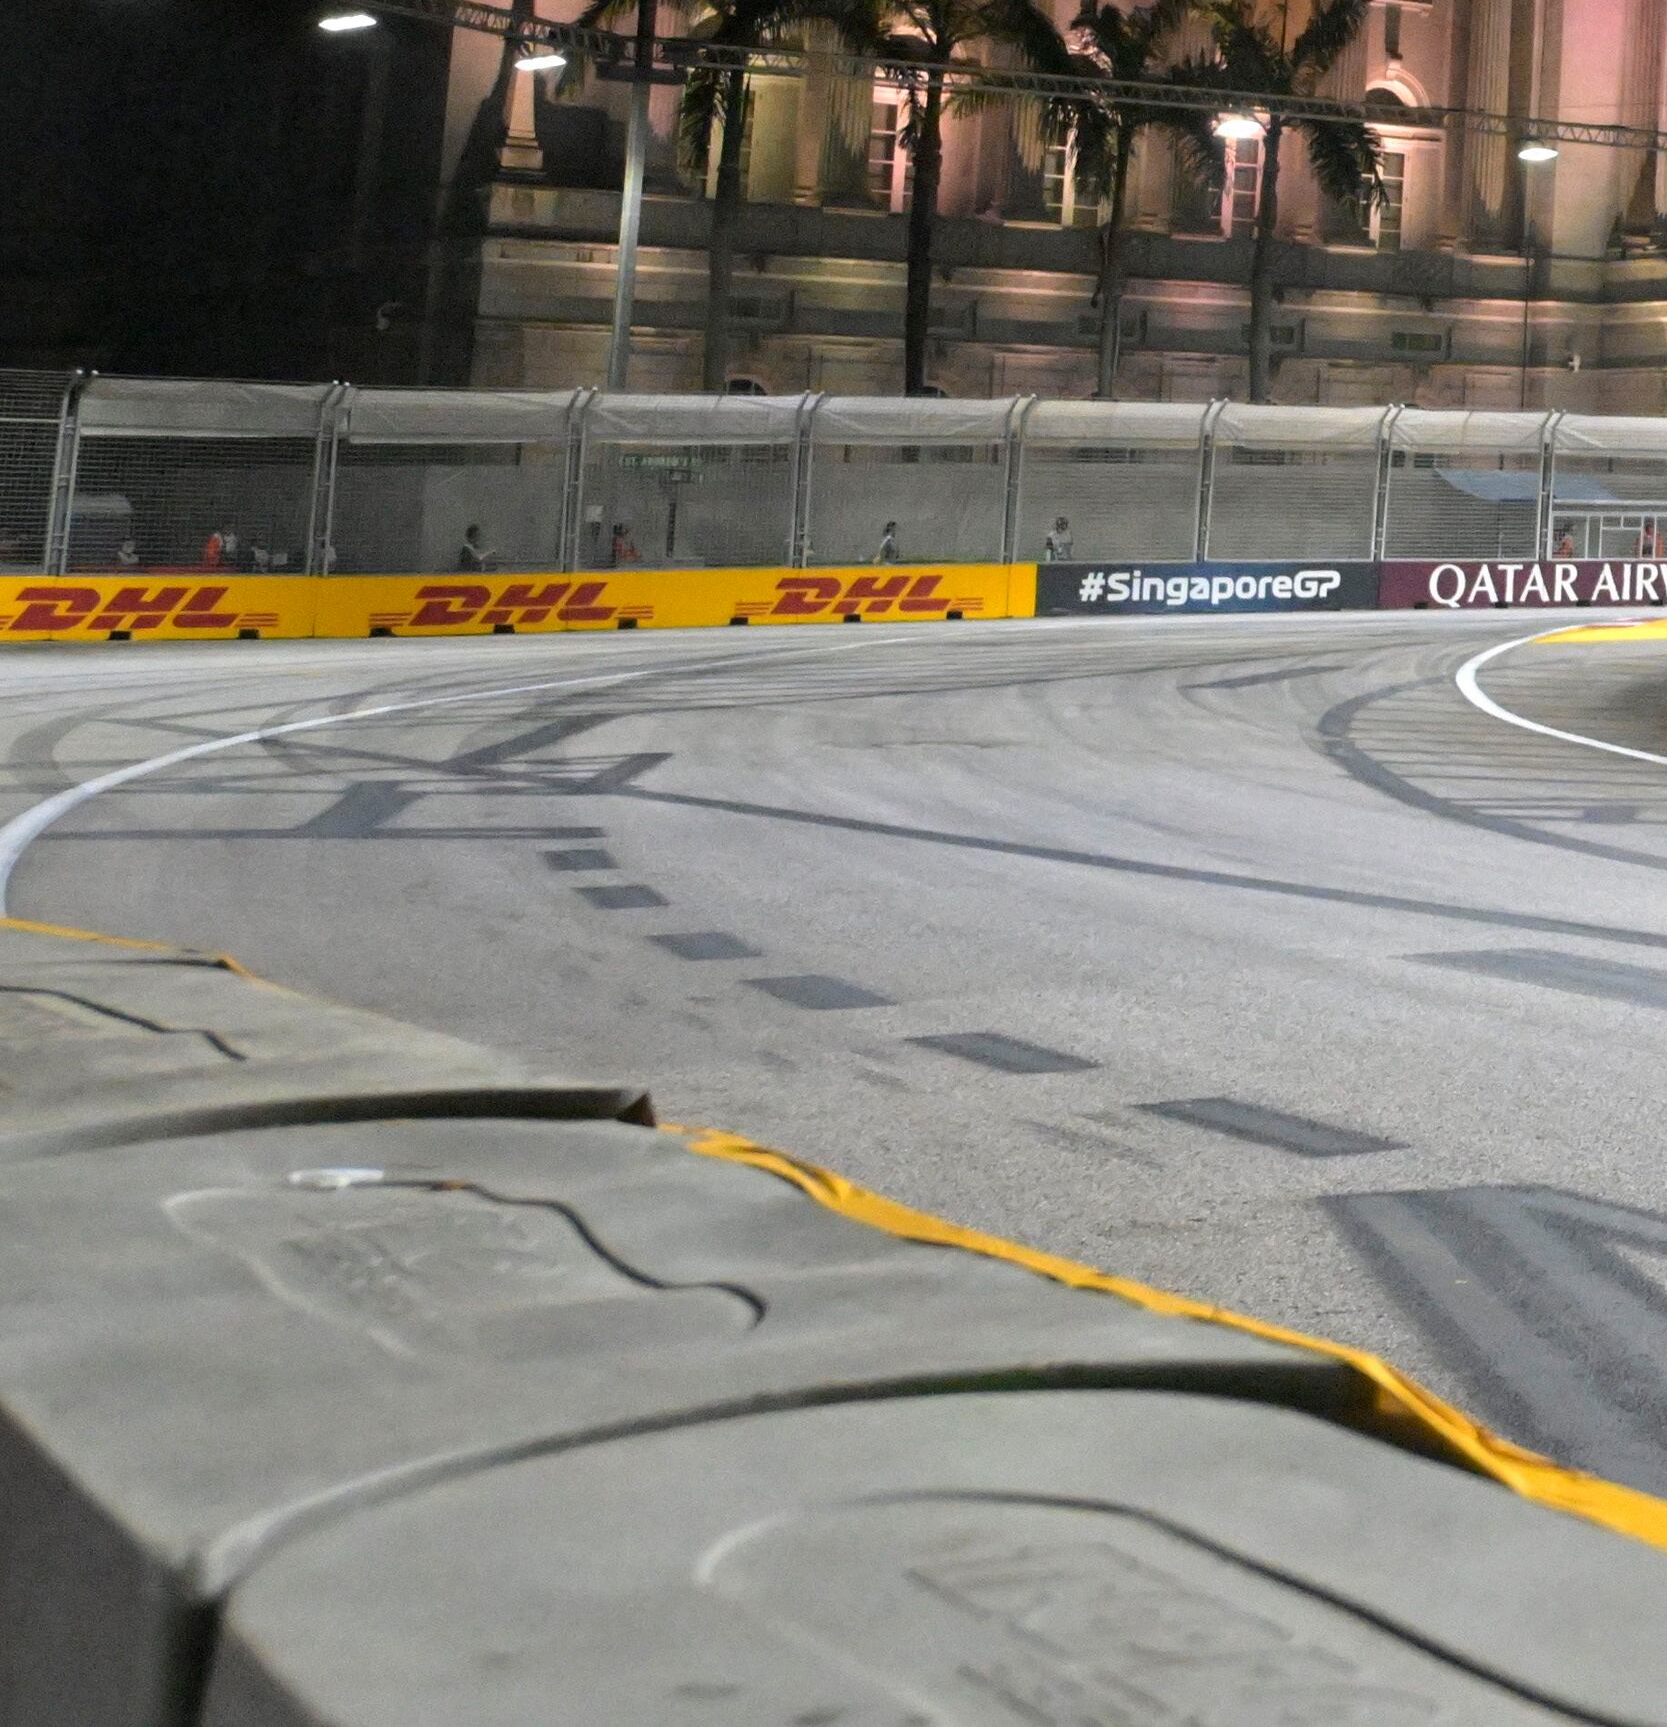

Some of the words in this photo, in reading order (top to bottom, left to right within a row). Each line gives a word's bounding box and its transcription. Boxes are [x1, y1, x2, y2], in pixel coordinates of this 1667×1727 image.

[409, 582, 619, 626] DHL
[772, 575, 951, 616] DHL
[1079, 570, 1342, 607] #SingaporeGP
[1429, 563, 1579, 609] QATAR
[10, 587, 240, 631] DHL
